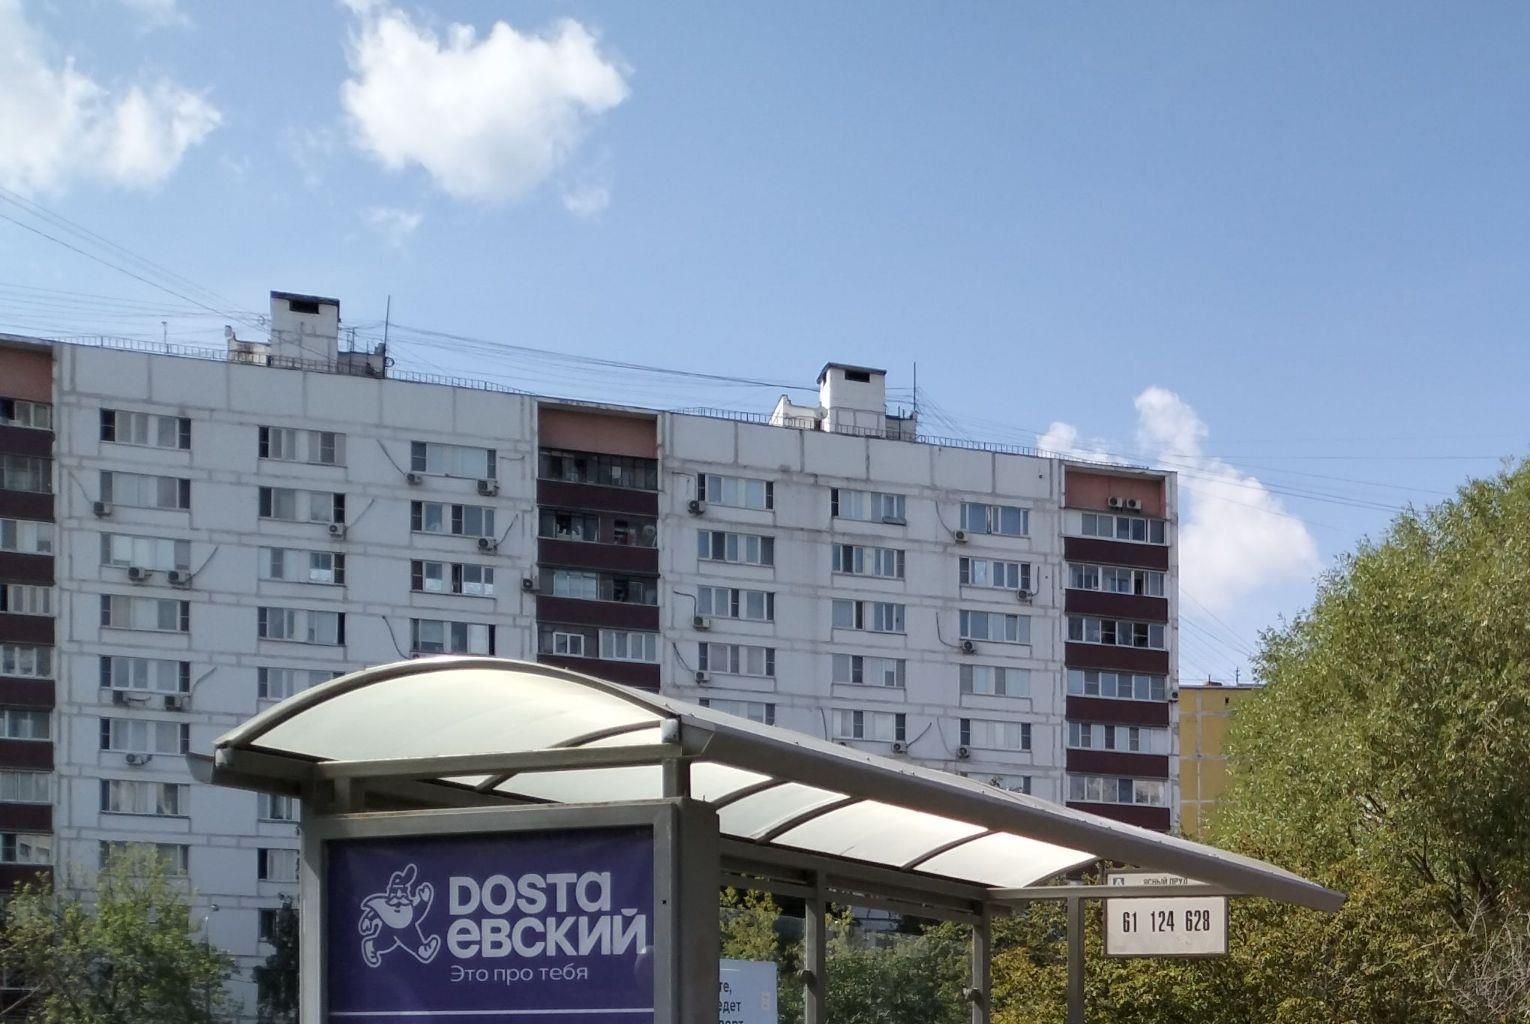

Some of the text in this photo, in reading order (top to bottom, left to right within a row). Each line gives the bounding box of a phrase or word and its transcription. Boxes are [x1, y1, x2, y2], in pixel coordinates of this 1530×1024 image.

[1122, 909, 1210, 932] 61 124 628
[450, 963, 588, 985] Это про тебя
